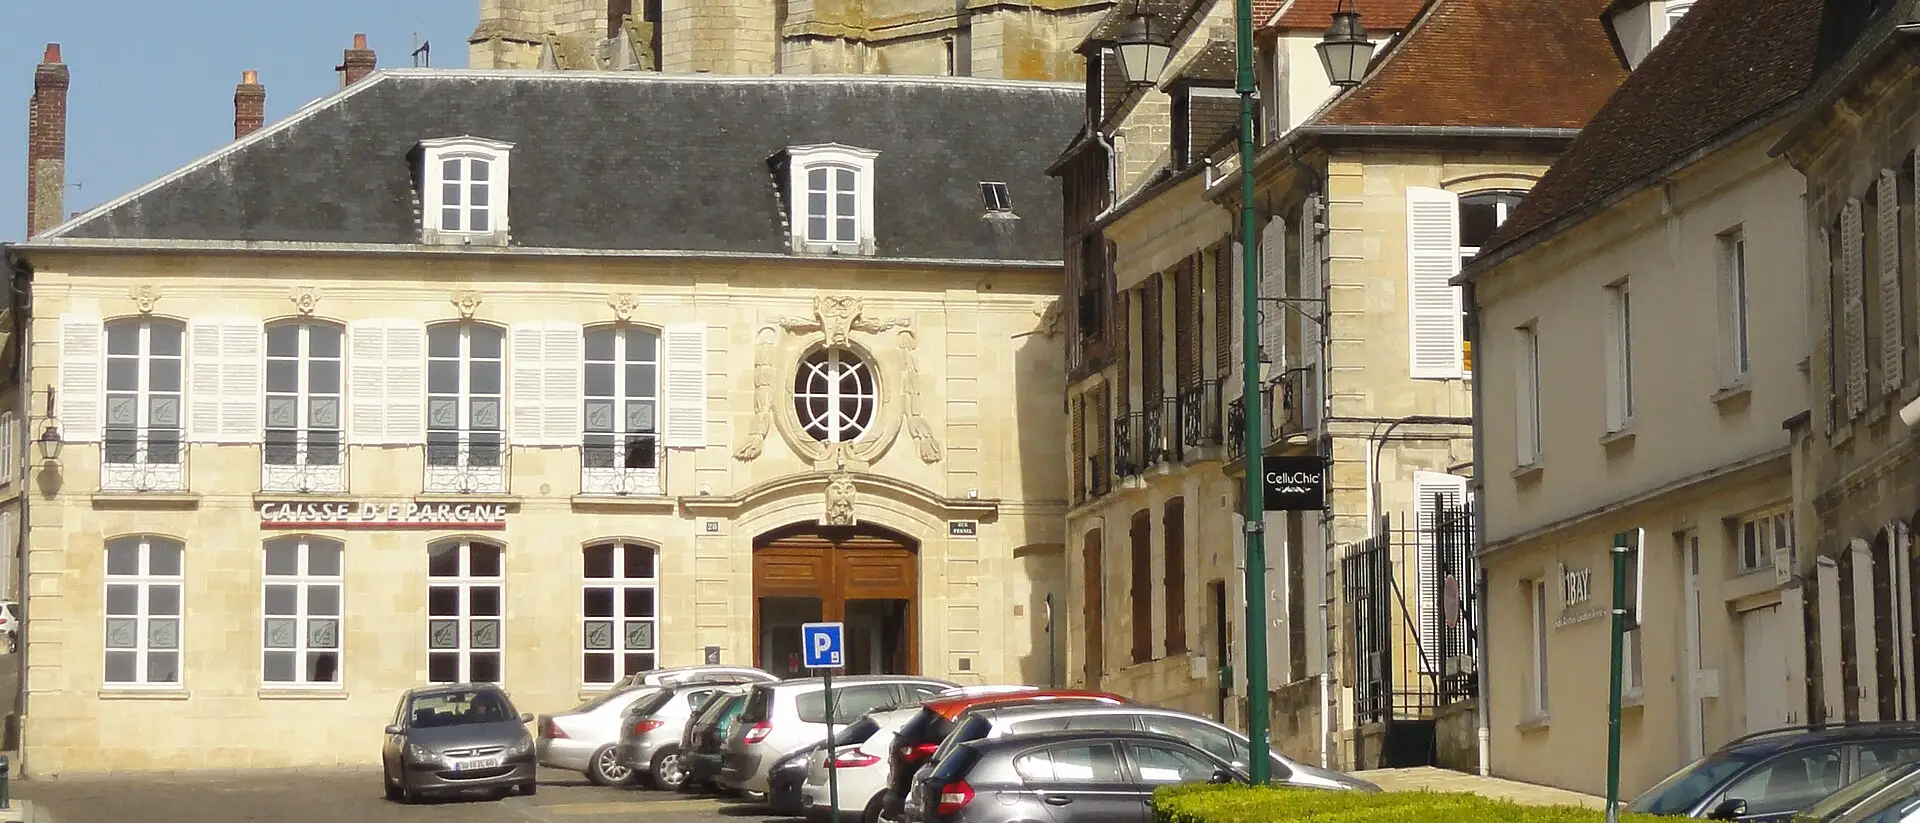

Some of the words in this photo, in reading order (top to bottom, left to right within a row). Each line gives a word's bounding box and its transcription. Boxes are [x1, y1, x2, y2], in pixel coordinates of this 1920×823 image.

[1266, 472, 1319, 484] CelluChic
[260, 502, 349, 521] CAISSE
[814, 632, 832, 659] P
